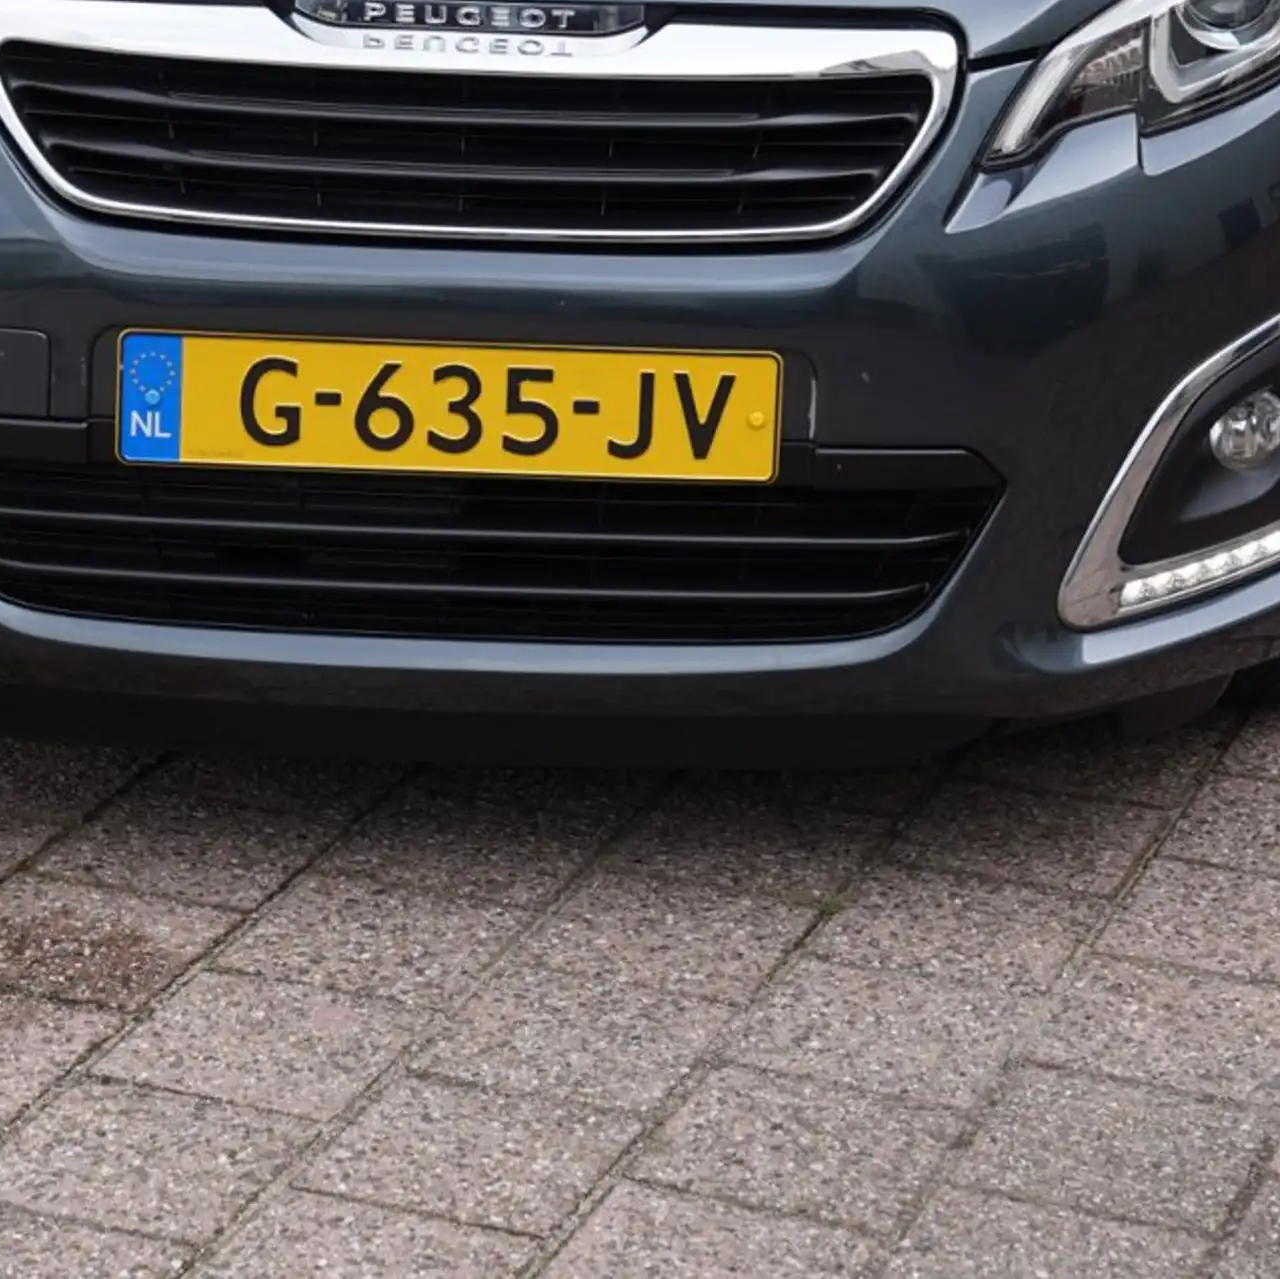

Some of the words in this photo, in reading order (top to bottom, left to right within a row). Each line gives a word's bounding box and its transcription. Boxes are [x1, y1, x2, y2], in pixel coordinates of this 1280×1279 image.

[363, 1, 576, 29] PEUGEOT
[237, 354, 737, 461] G-635-JV
[130, 410, 172, 438] NL
